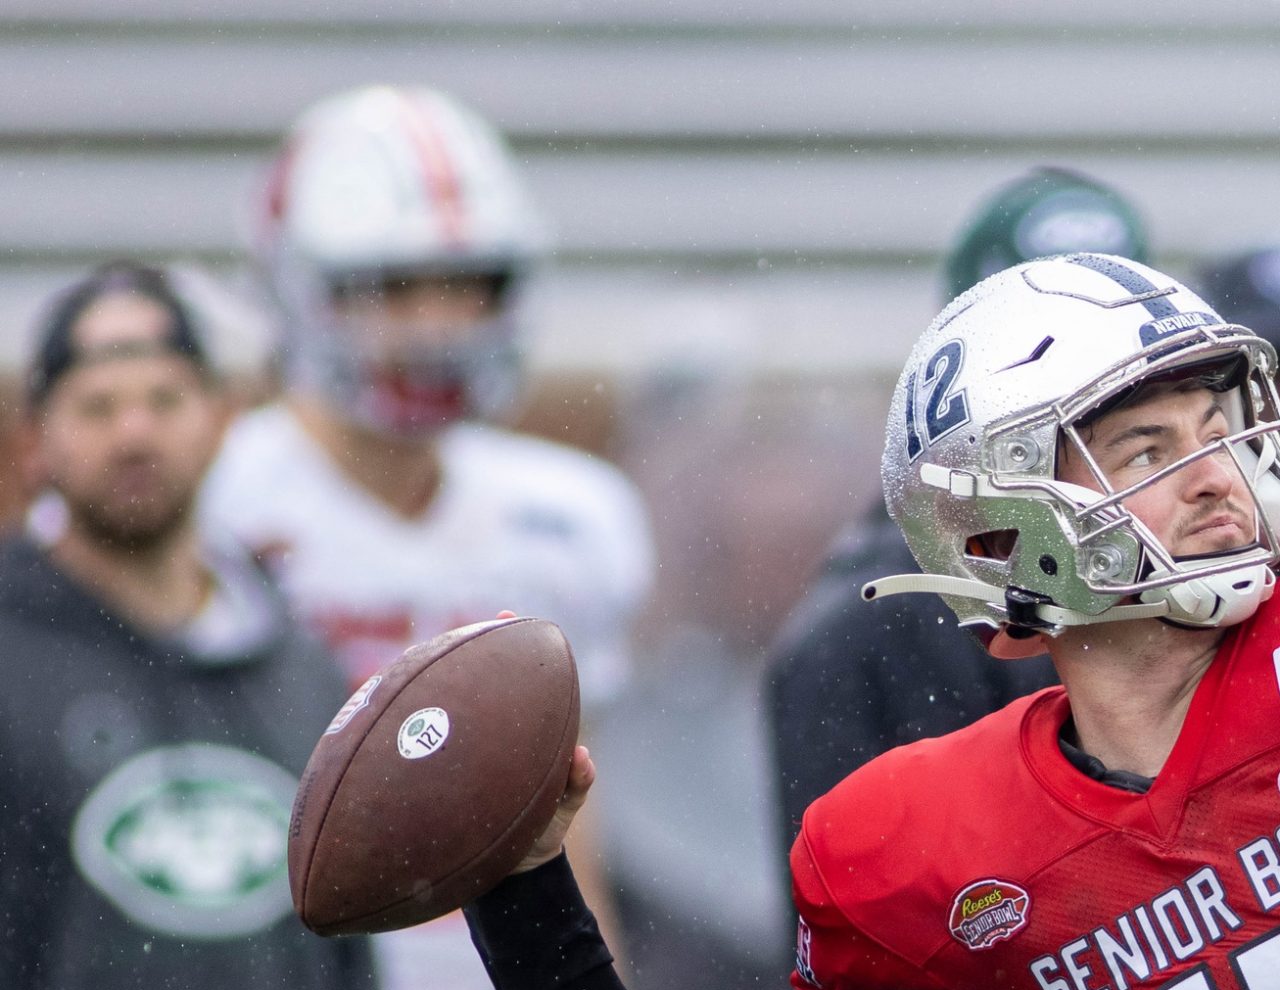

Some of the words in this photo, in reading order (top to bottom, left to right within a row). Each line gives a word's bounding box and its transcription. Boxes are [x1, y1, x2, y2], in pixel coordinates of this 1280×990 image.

[1151, 312, 1207, 335] NEVADA
[904, 338, 970, 465] 12
[416, 724, 442, 750] 127
[962, 889, 1001, 917] Reese's
[963, 911, 995, 942] SENIOR
[993, 902, 1019, 925] BOWL
